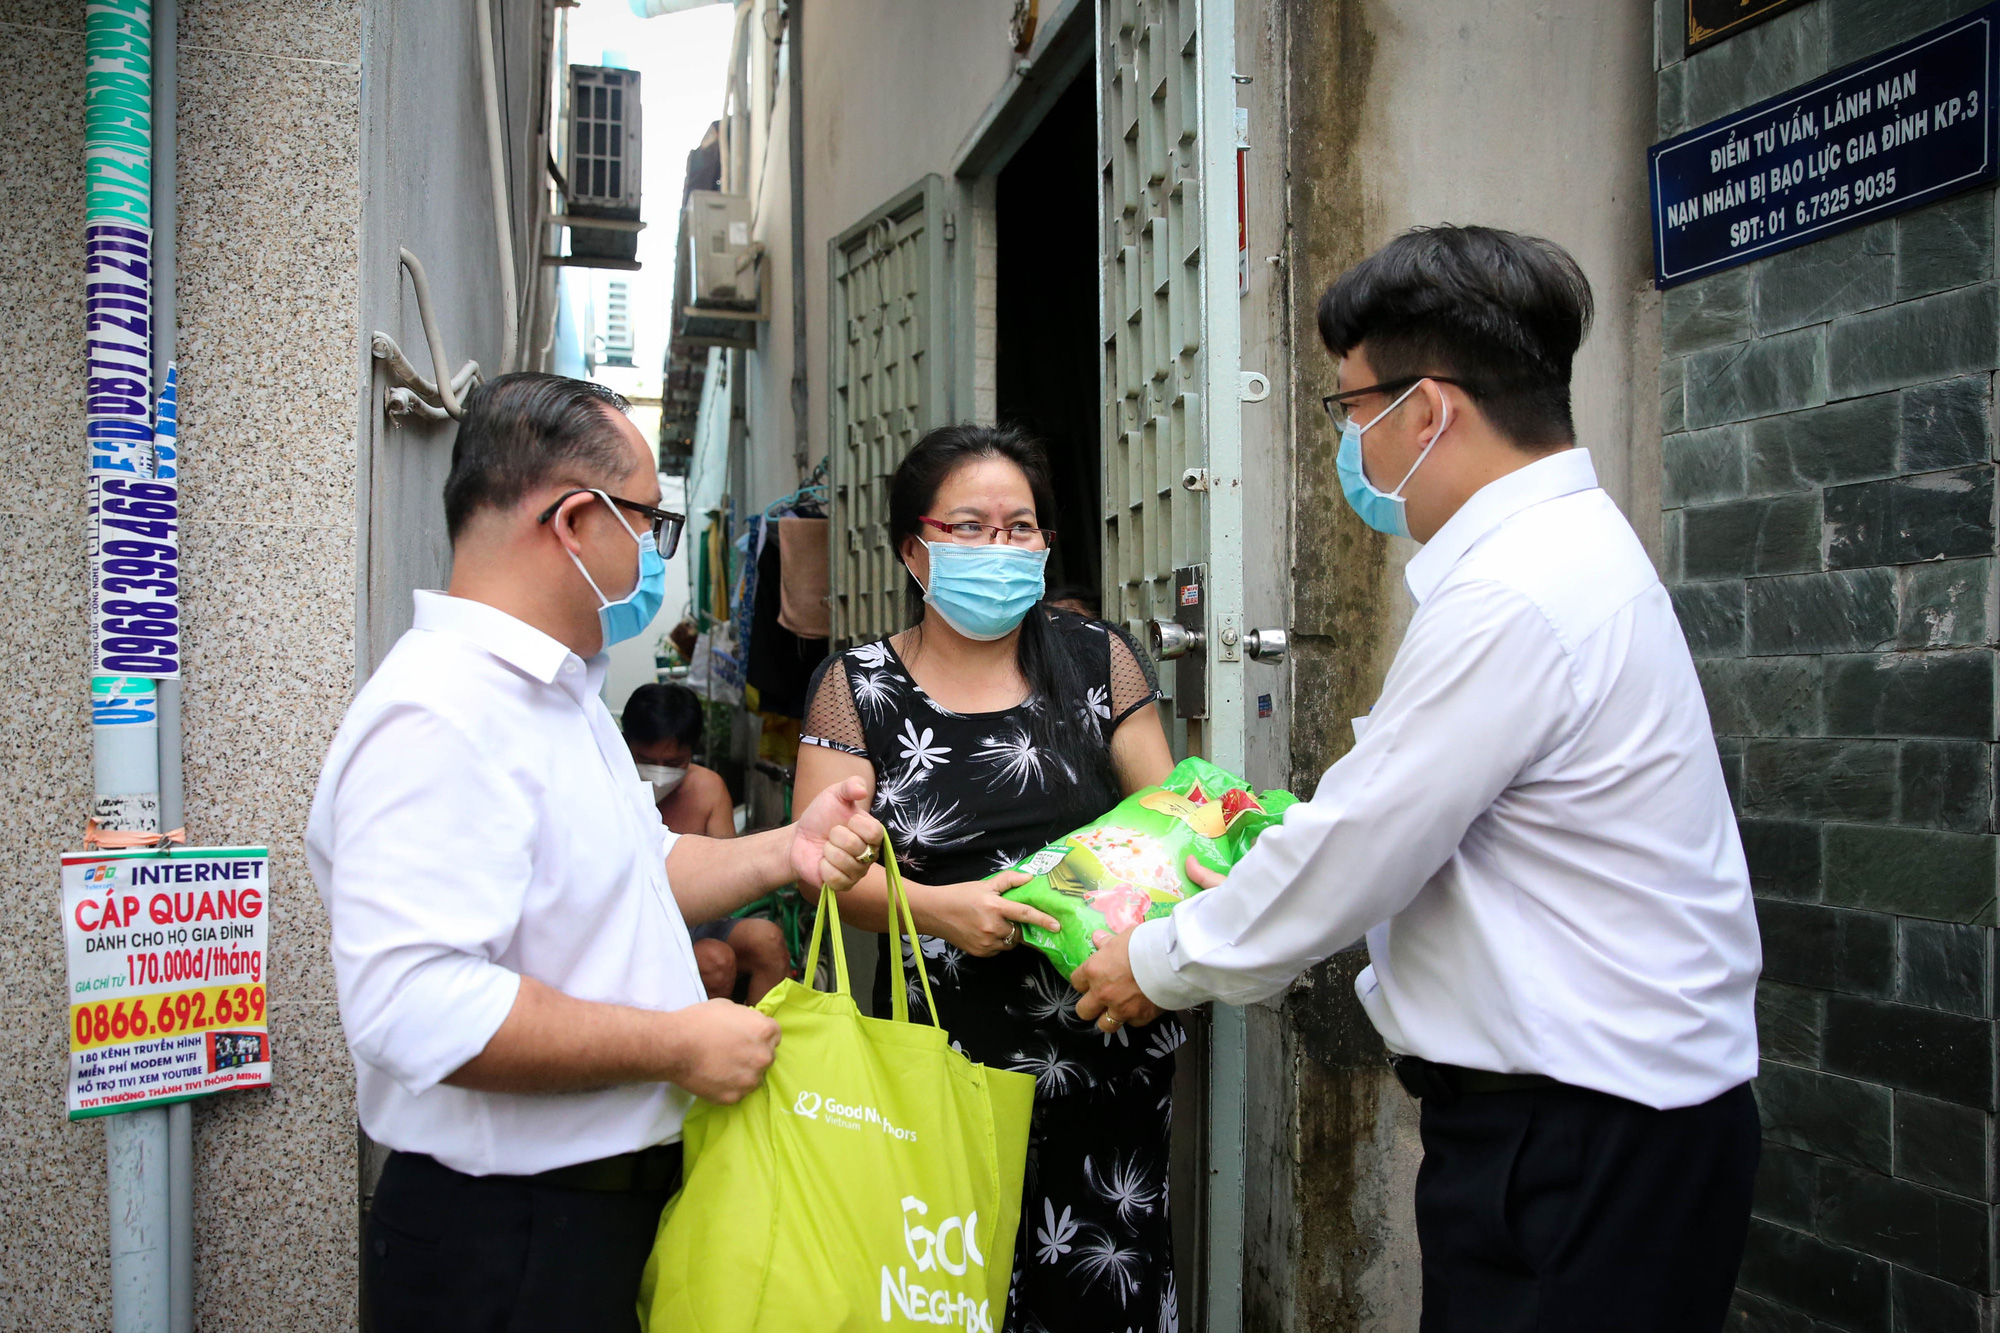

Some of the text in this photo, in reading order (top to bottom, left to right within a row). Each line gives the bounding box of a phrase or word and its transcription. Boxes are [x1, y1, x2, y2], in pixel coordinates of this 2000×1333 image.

[1710, 69, 1917, 174] ĐIỂM TƯ VẤN, LÁNH NẠN
[1667, 90, 1978, 231] NẠN NHÂN BỊ BẠO LỰC GIA ĐÌNH KP.3
[1730, 167, 1896, 248] SĐT: 01 6.7325 9035
[84, 865, 117, 882] FPT
[131, 861, 263, 886] INTERNET
[75, 888, 263, 932] CÁP QUANG
[86, 921, 254, 953] DÀNH CHO HỘ GIA ĐÌNH
[75, 977, 91, 993] GIÁ
[76, 986, 265, 1045] 0866.692.639
[80, 1054, 98, 1064] 180
[101, 1047, 131, 1061] KÊNH
[177, 1036, 202, 1050] HÌNH
[108, 1060, 127, 1074] PHÍ
[130, 1055, 172, 1071] MODEM
[175, 1052, 197, 1065] WIFI
[80, 1098, 99, 1108] TIVI
[185, 1081, 202, 1091] TIVI
[237, 1073, 262, 1081] MINH
[118, 1077, 136, 1088] TIVI
[139, 1073, 160, 1084] XEM
[162, 1066, 203, 1080] YOUTUBE
[825, 1097, 863, 1120] Good
[825, 1113, 861, 1131] Vietnam
